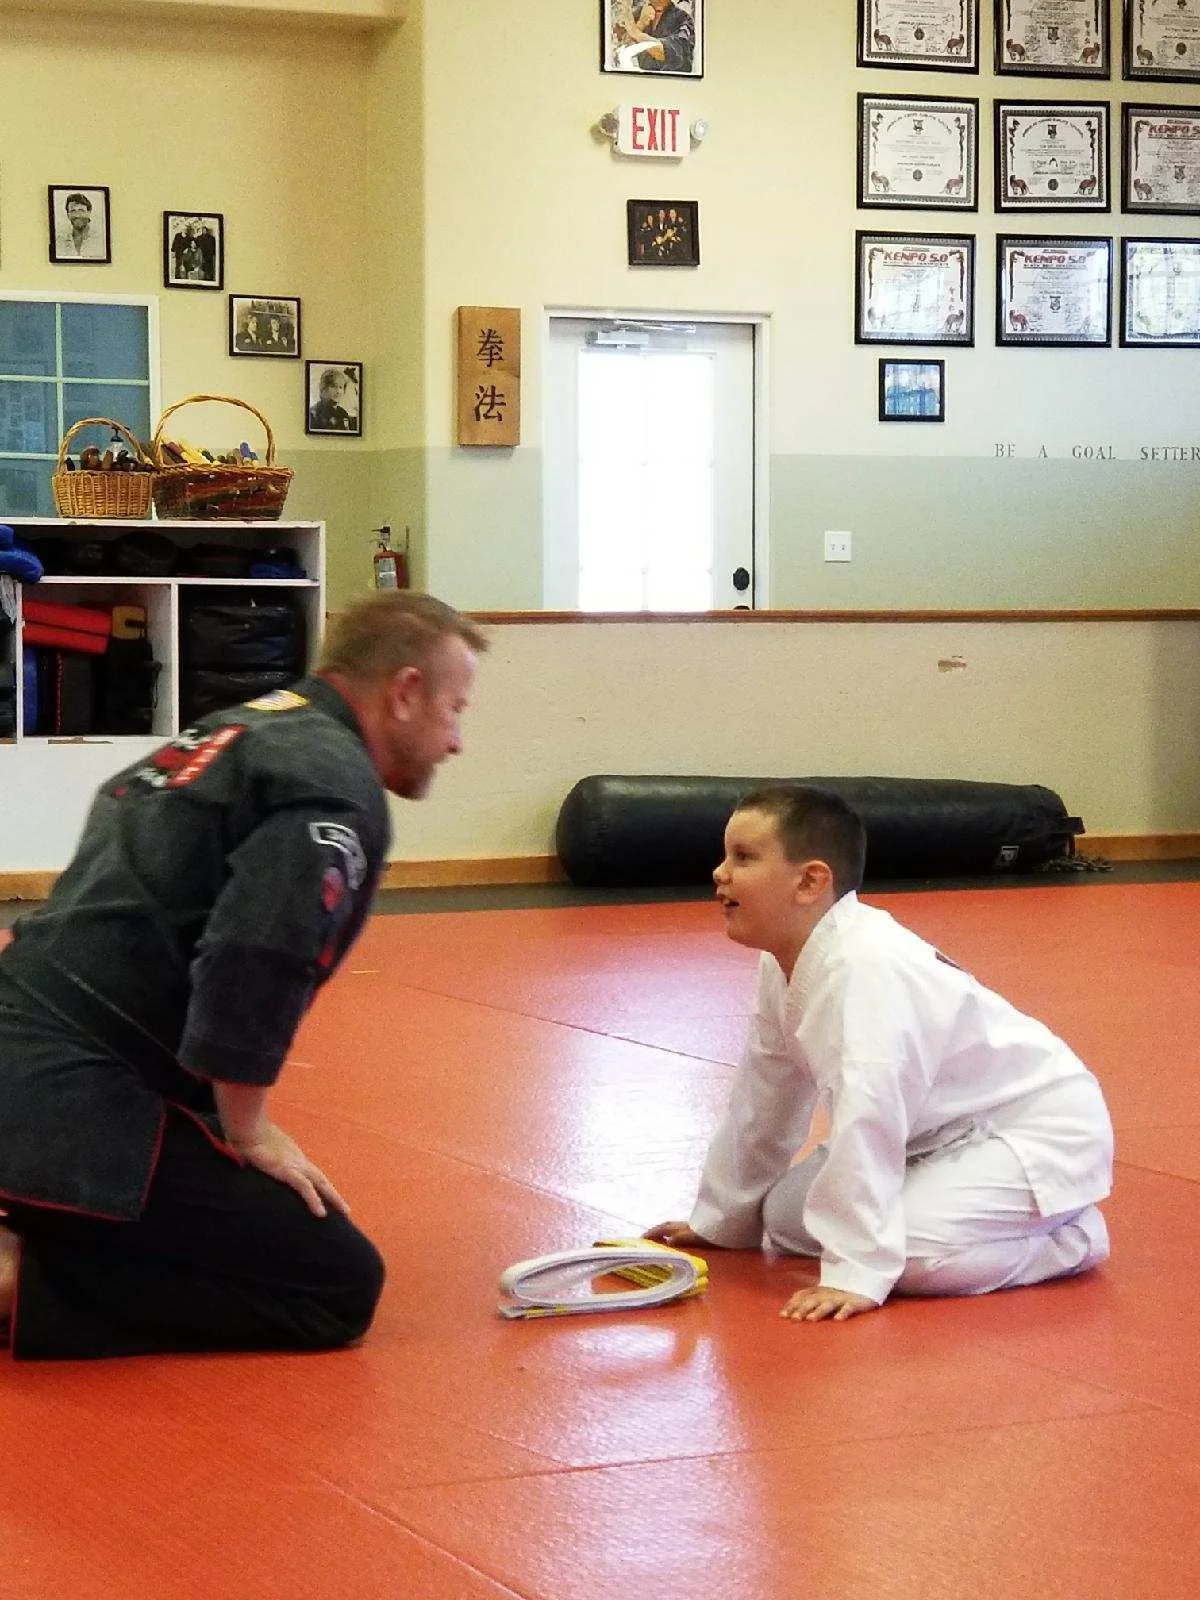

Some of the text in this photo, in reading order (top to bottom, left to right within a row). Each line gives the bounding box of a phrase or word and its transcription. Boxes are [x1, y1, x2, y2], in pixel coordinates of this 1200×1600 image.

[632, 107, 680, 152] EXIT
[1149, 124, 1189, 133] KENPO
[884, 251, 927, 262] KENPO
[1024, 254, 1066, 264] KENPO
[473, 328, 507, 422] 拳法
[994, 443, 1200, 461] BE A GOAL SETTER
